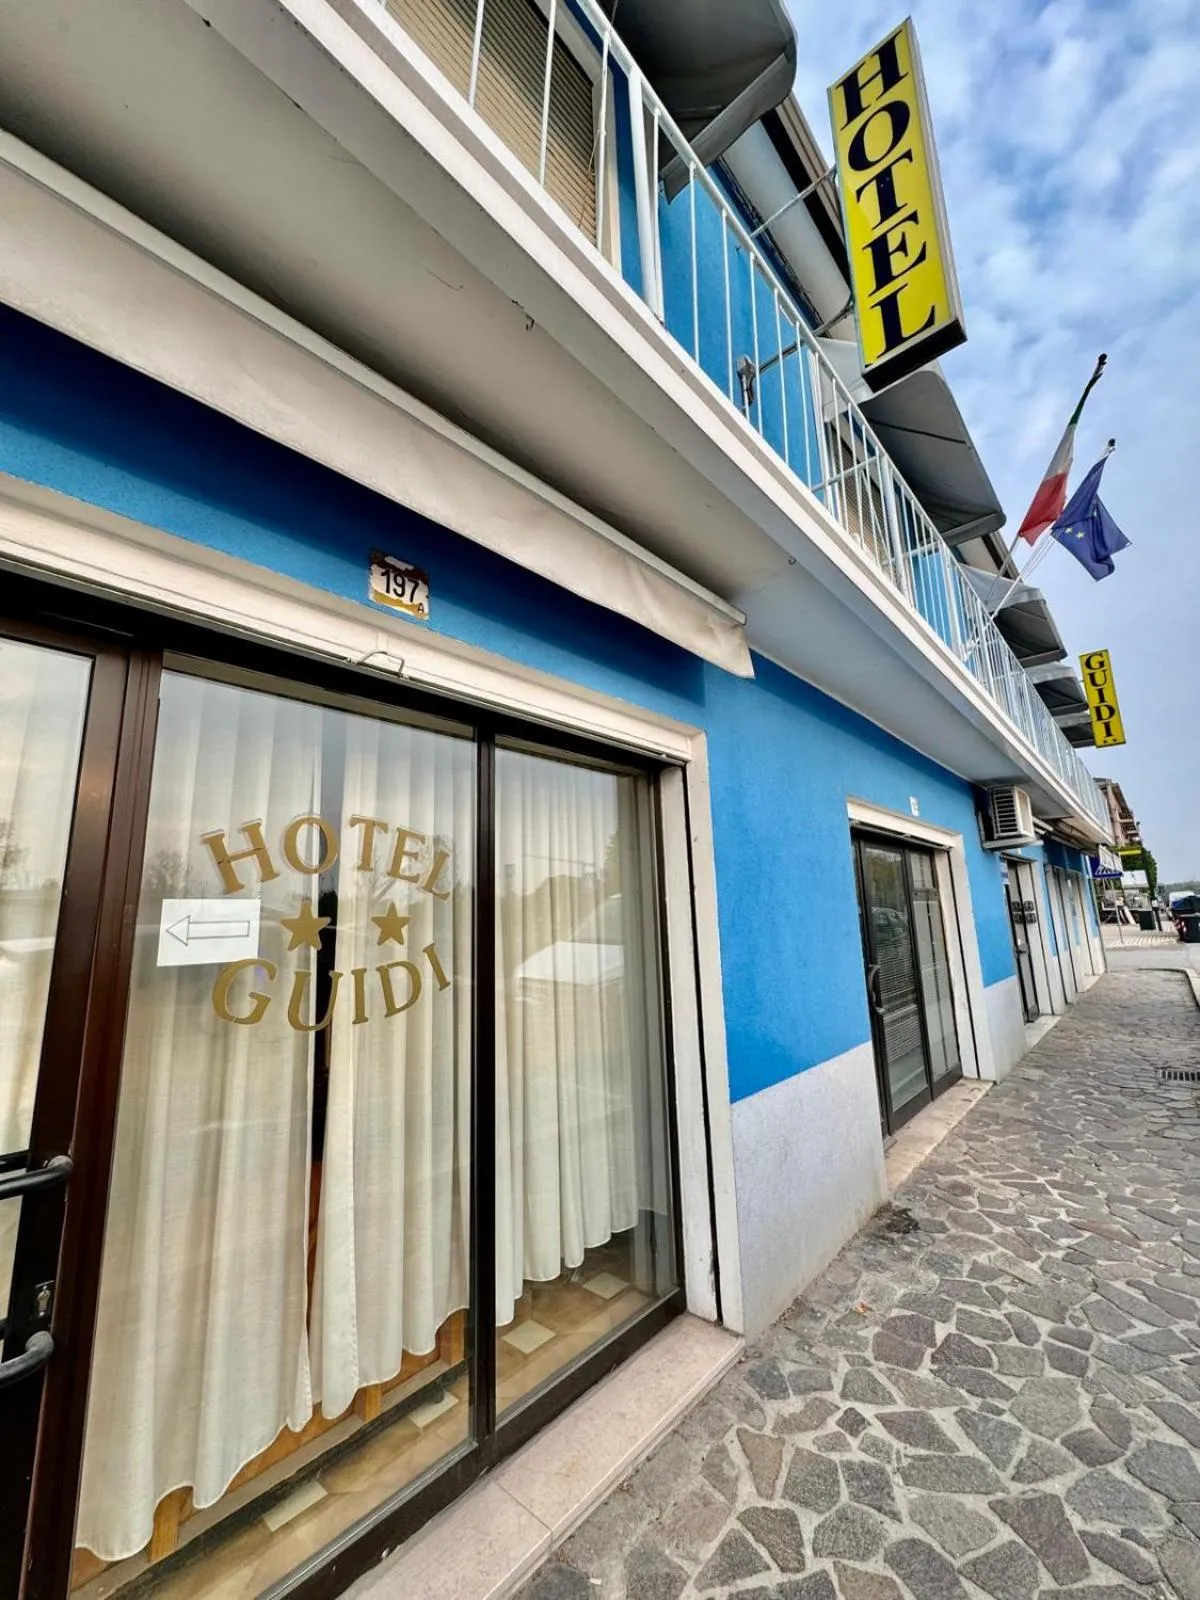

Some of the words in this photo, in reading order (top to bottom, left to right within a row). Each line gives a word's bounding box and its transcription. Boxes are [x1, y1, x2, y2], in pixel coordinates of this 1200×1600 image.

[836, 29, 936, 359] HOTEL
[381, 569, 419, 603] 197
[417, 602, 425, 613] A
[1084, 653, 1116, 738] GUIDI
[200, 813, 451, 900] HOTEL
[211, 943, 451, 1032] GUIDI
